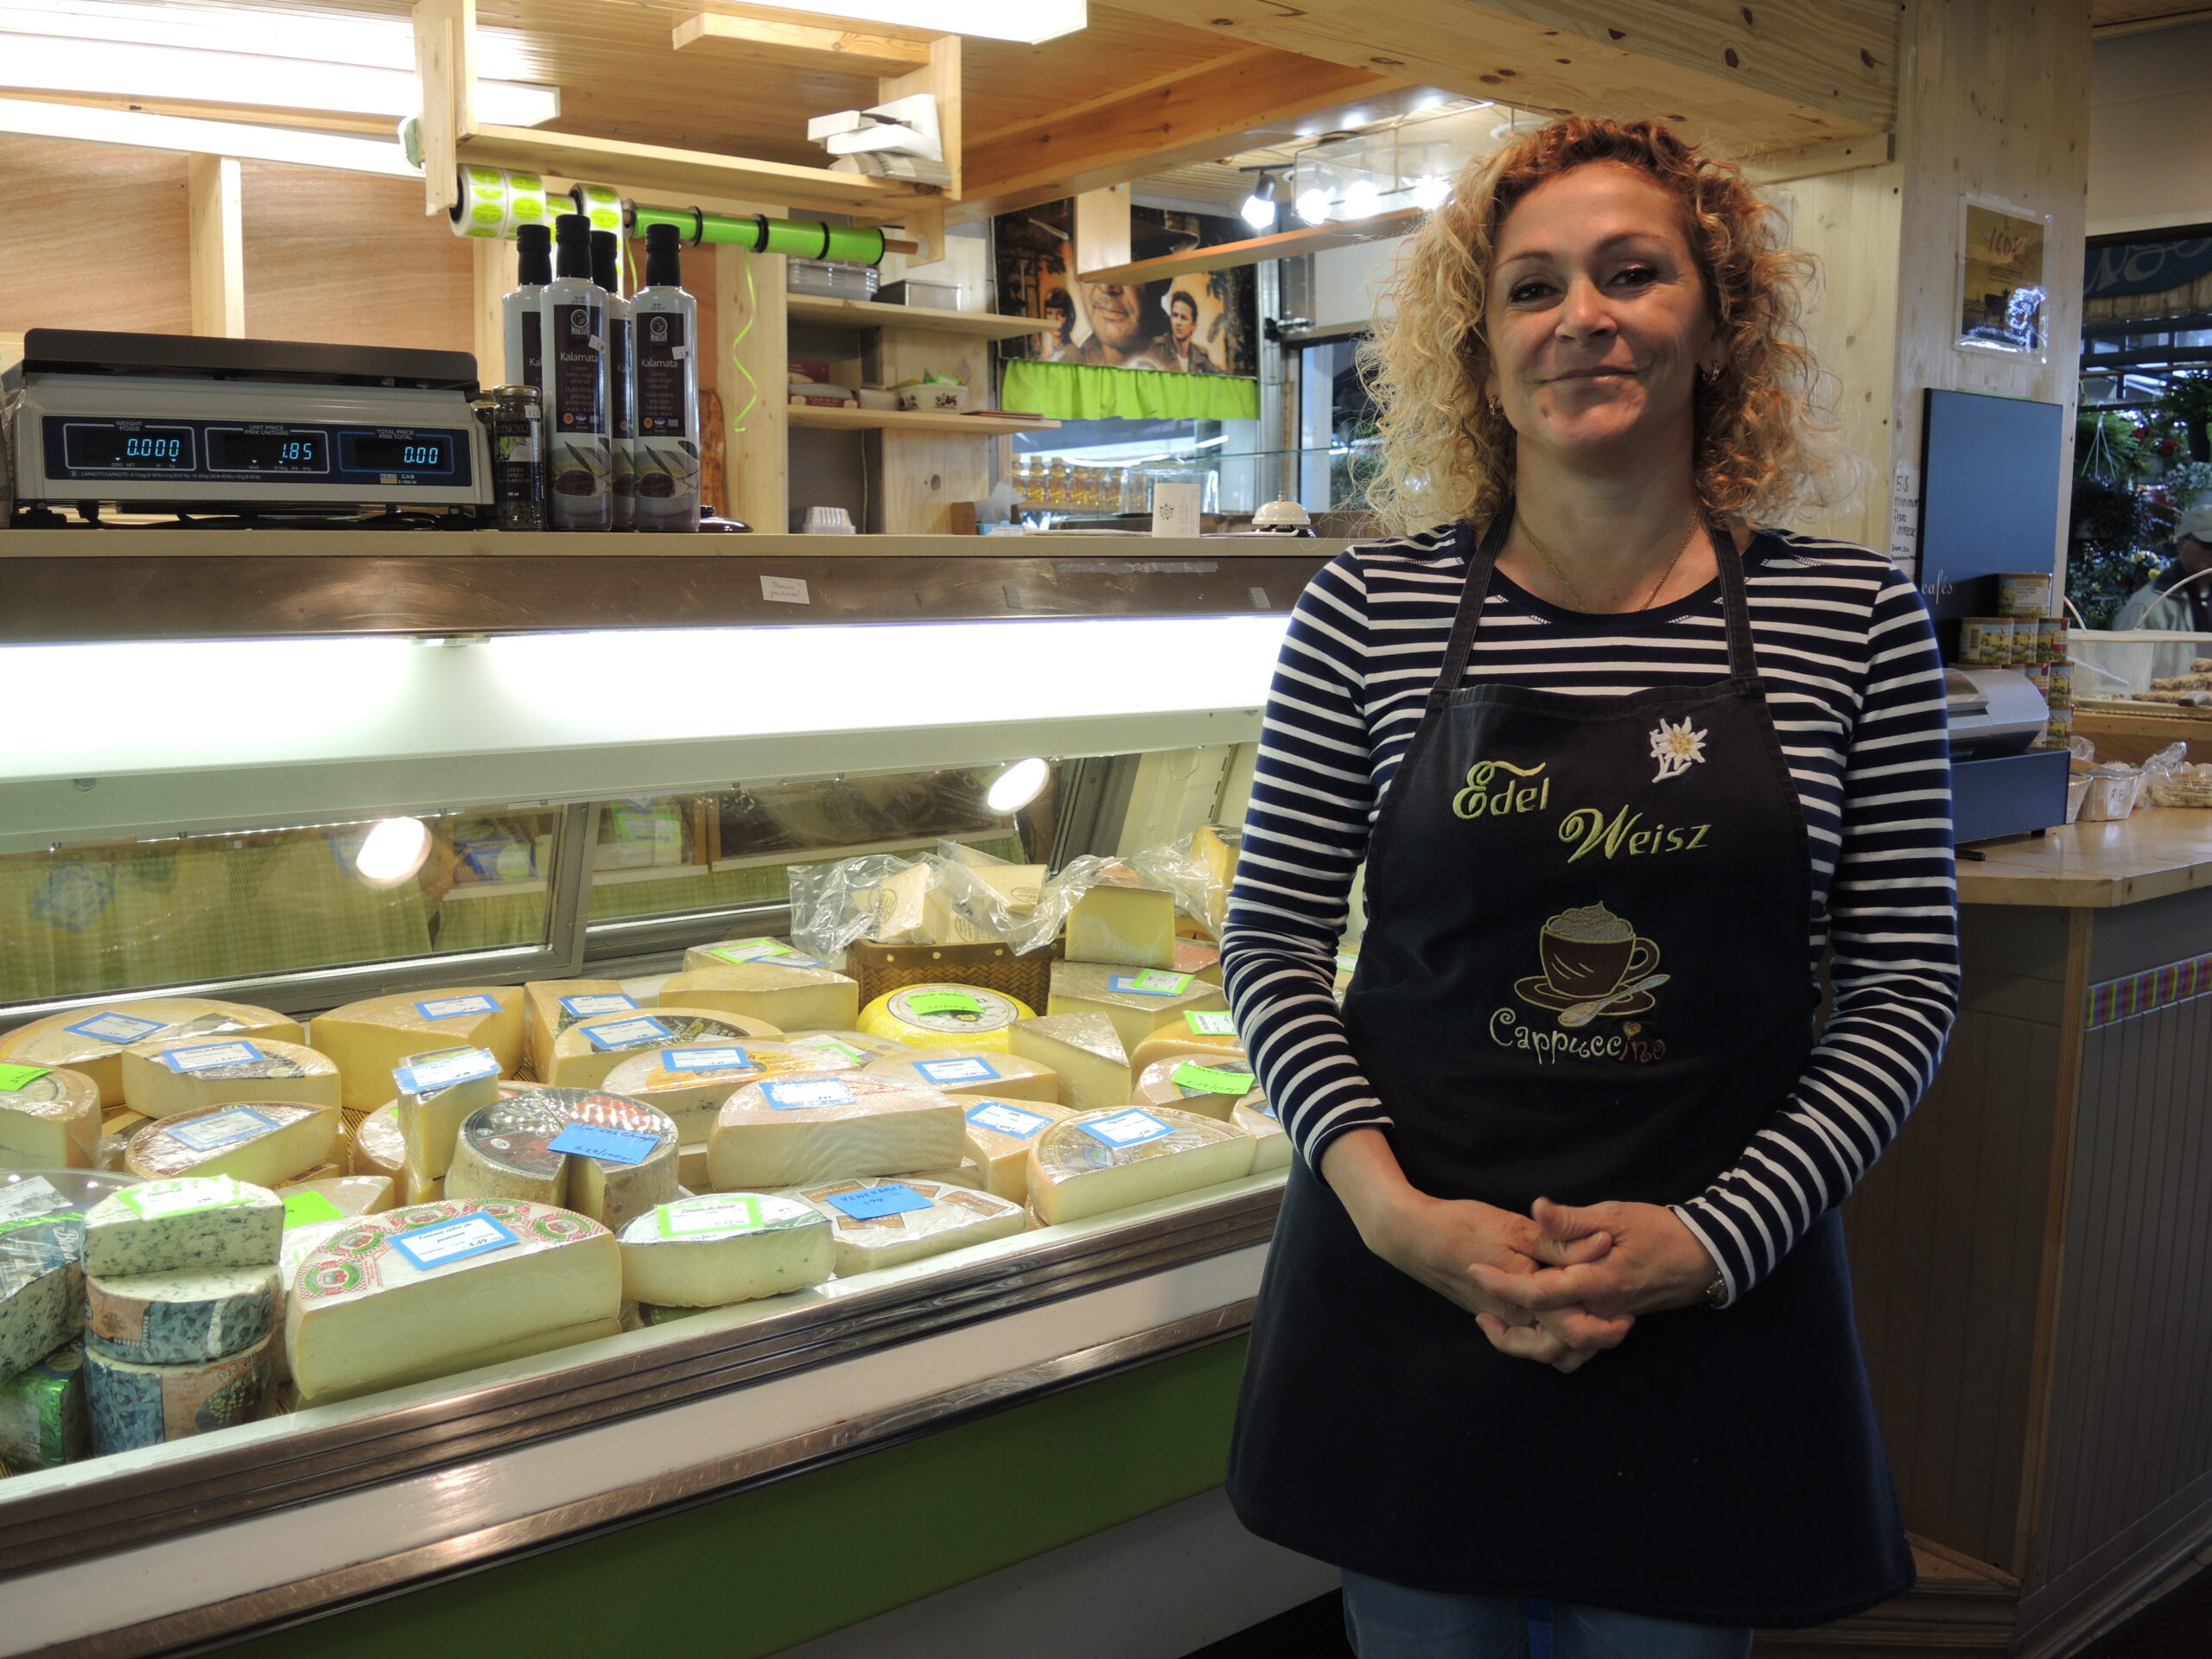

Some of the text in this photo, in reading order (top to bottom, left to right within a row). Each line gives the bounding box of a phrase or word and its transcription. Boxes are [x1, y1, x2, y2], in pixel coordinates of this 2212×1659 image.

[560, 352, 599, 364] Kalamata
[641, 358, 678, 369] Kalamata
[126, 438, 181, 458] 0.000
[282, 442, 313, 461] 1.85
[404, 446, 439, 465] 0.00
[1921, 568, 1953, 605] cafés
[1452, 760, 1550, 820] Edel
[1558, 804, 1713, 864] Weisz
[1490, 1007, 1666, 1065] Cappuccino
[417, 1230, 445, 1241] Tomme
